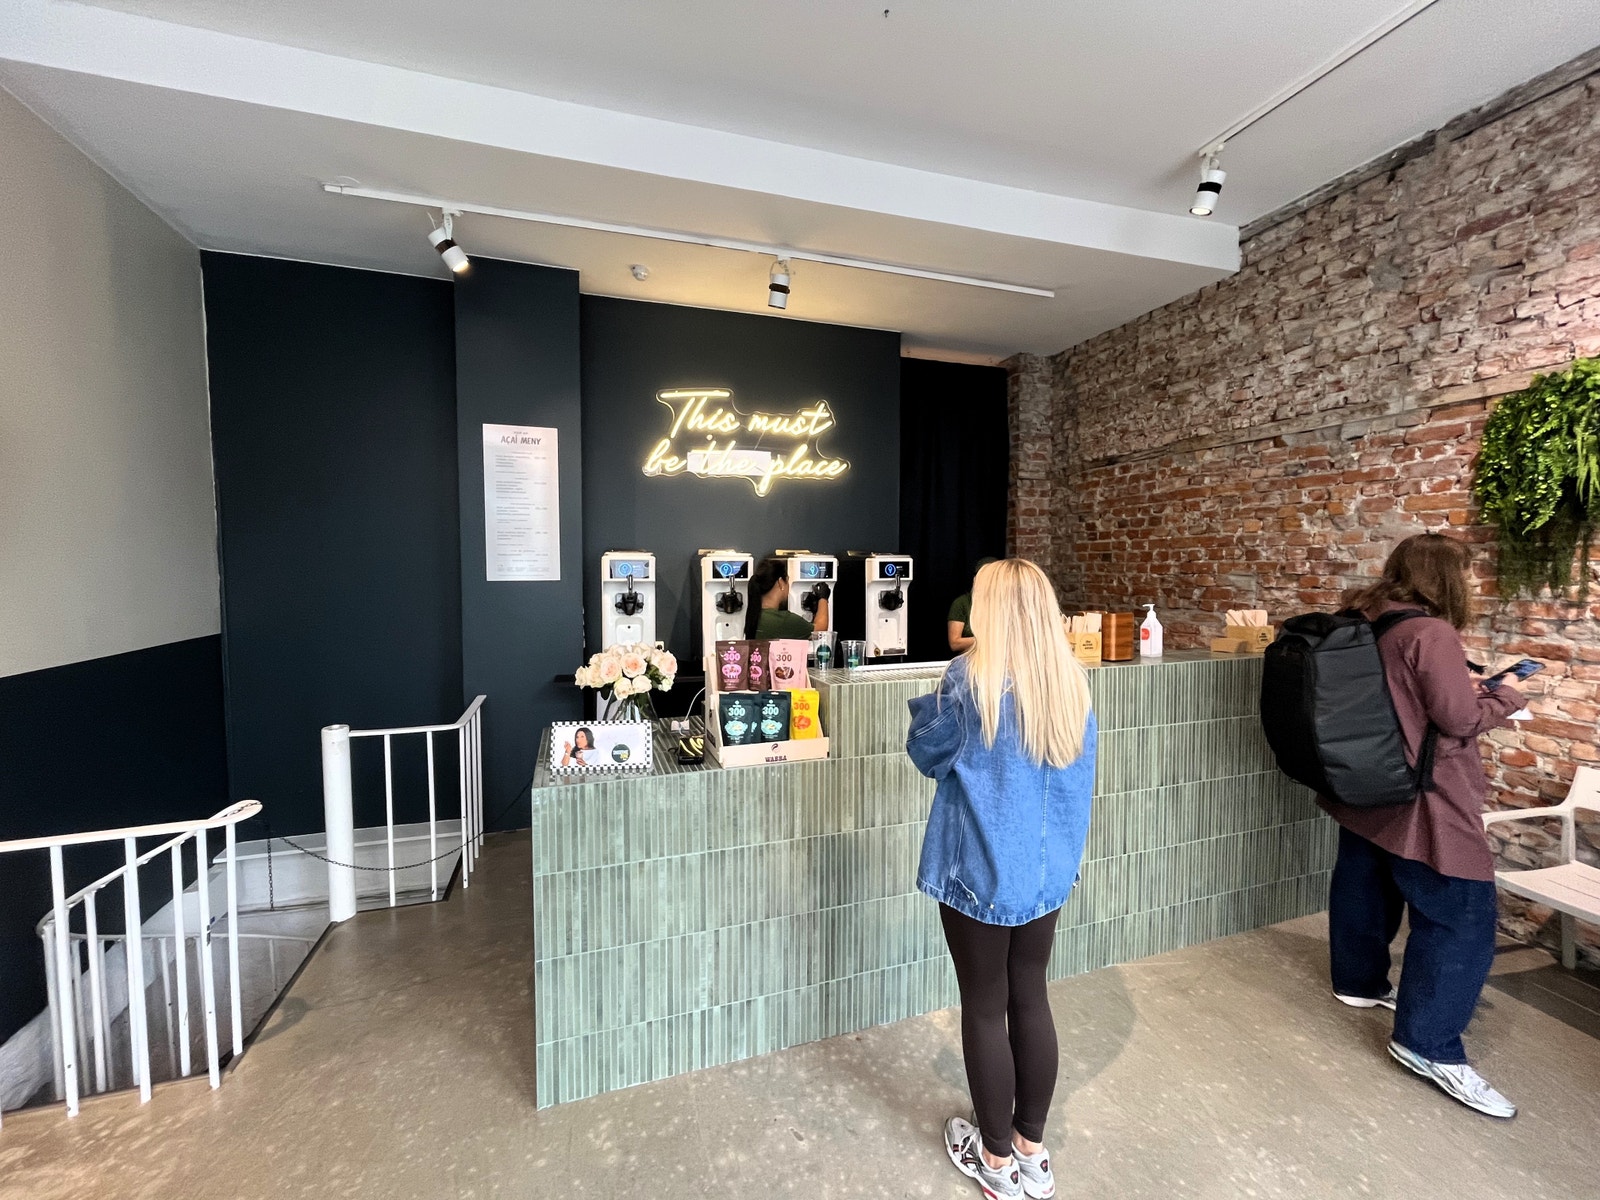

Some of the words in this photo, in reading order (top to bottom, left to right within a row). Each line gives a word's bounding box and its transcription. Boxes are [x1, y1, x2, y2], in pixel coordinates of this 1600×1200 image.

[660, 390, 741, 439] This
[749, 402, 832, 436] must
[520, 436, 541, 446] MENY
[645, 438, 687, 473] be
[690, 440, 758, 474] the
[759, 443, 848, 493] place
[723, 652, 741, 661] 300
[776, 653, 792, 662] 300
[762, 706, 779, 715] 300
[794, 702, 810, 710] 300
[728, 707, 746, 716] 300
